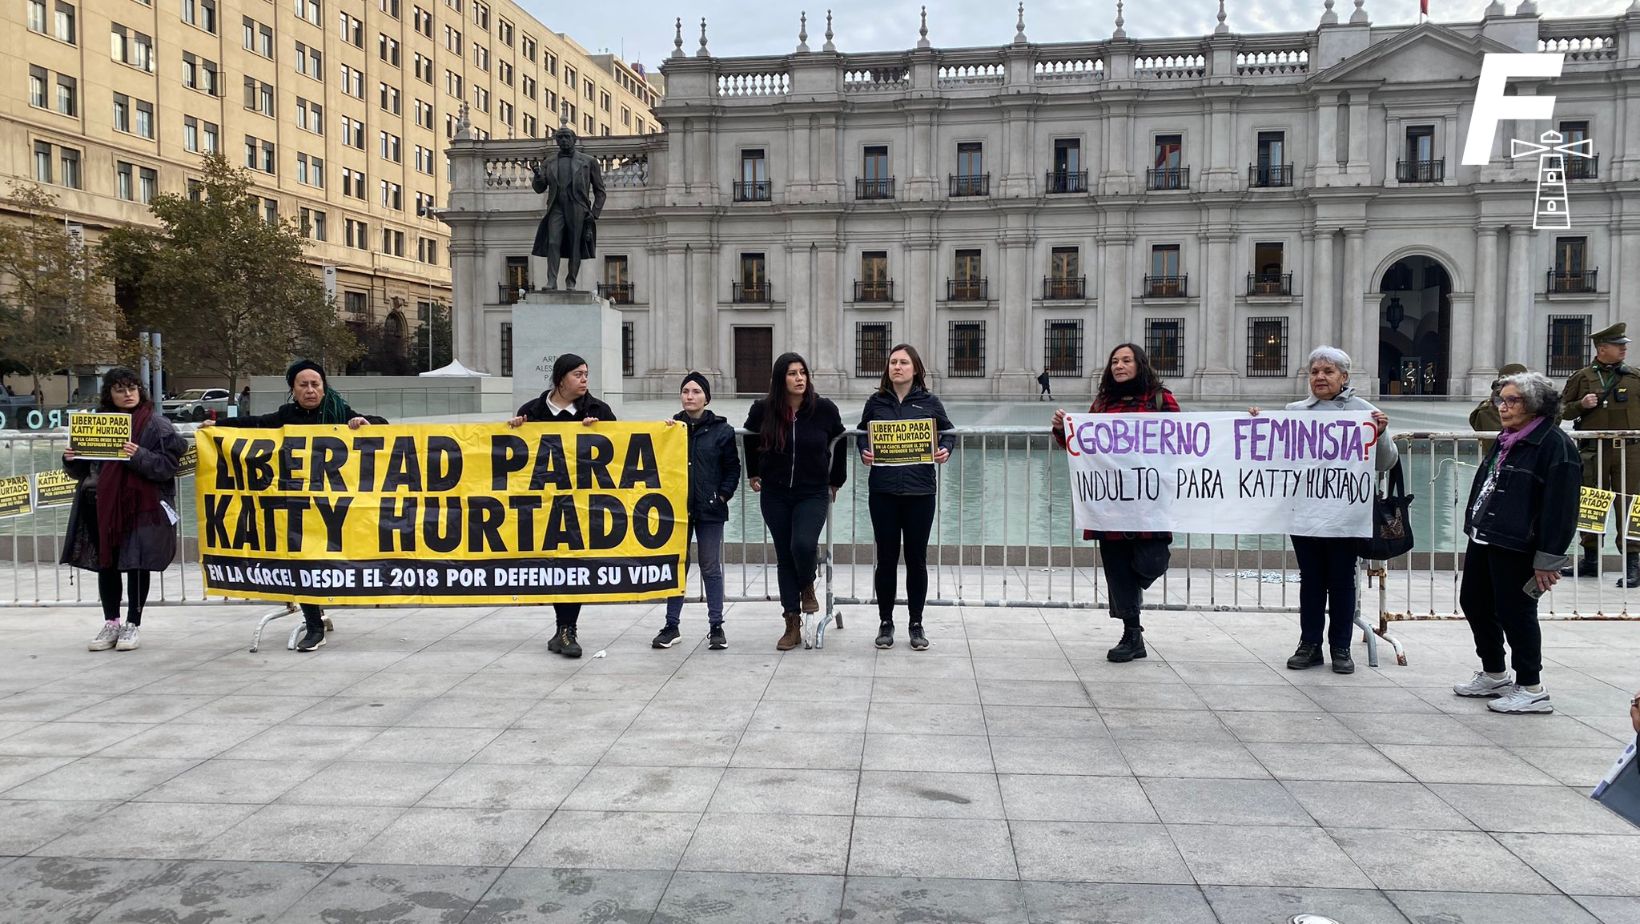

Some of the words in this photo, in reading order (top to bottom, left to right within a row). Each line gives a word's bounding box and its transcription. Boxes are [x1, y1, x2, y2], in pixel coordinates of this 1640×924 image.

[72, 416, 107, 425] LIBERTAD
[110, 417, 128, 426] PARA
[96, 427, 128, 435] HURTADO
[873, 424, 906, 433] LIBERTAD
[910, 422, 930, 431] PARA
[896, 432, 930, 441] HURTADO
[1066, 416, 1210, 457] ¿GOBIERNO
[1234, 418, 1378, 461] FEMINISTA?
[214, 436, 463, 492] LIBERTAD
[492, 433, 661, 491] PARA
[8, 476, 27, 486] PARA
[39, 476, 59, 485] KATTY
[1077, 467, 1160, 502] INDULTO
[1176, 468, 1224, 499] PARA
[1240, 468, 1302, 498] KATTY
[1306, 468, 1370, 505] HURTADO
[0, 484, 28, 495] URTADO
[1589, 490, 1611, 500] PARA
[204, 494, 355, 552] KATTY
[378, 493, 674, 552] HURTADO
[208, 564, 224, 582] EN
[228, 565, 246, 584] LA
[248, 562, 296, 587] CÁRCEL
[302, 569, 355, 587] DESDE
[363, 568, 382, 587] EL
[390, 568, 439, 587] 2018
[446, 568, 487, 587] POR
[495, 567, 590, 586] DEFENDER
[597, 566, 621, 585] SU
[628, 564, 672, 584] VIDA
